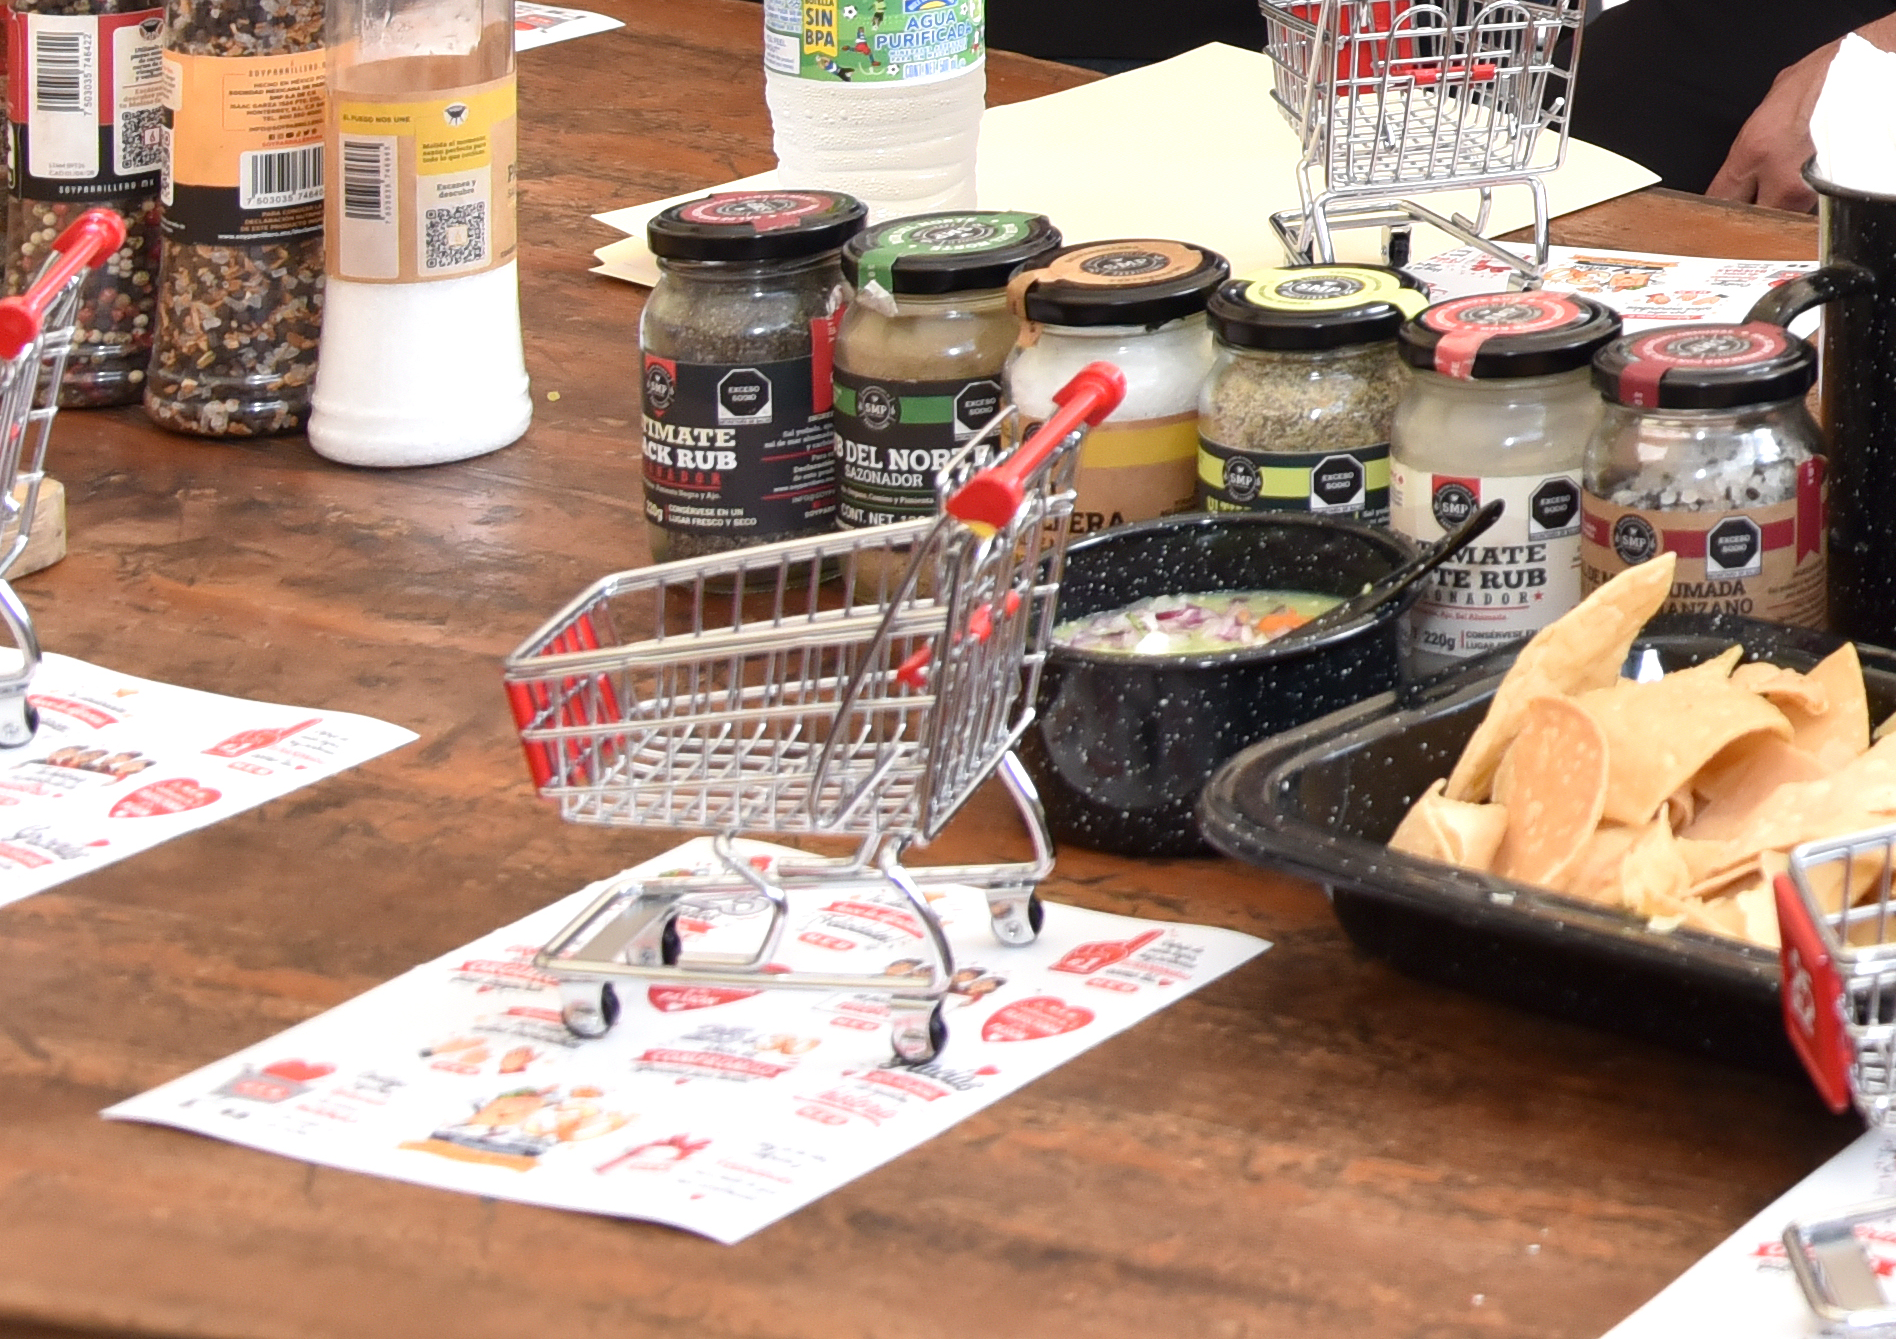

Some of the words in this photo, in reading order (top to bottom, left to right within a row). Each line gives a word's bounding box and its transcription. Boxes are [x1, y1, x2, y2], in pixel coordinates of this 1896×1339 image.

[806, 7, 833, 27] SIN
[906, 10, 957, 31] AGUA
[806, 29, 835, 47] BPA
[876, 20, 973, 50] PURIFICADA
[257, 195, 294, 204] 503035
[728, 385, 760, 393] EXCESO
[676, 448, 737, 470] RUB
[845, 440, 883, 470] DEL
[844, 463, 924, 488] SAZONADOR
[1230, 473, 1253, 486] SMP
[1321, 471, 1354, 482] EXCESO
[1442, 501, 1469, 514] SMP
[1540, 494, 1571, 506] EXCESO
[717, 508, 729, 516] EN
[691, 517, 724, 526] FRESCO
[1622, 536, 1647, 549] SMP
[1718, 534, 1751, 544] EXCESO
[1480, 567, 1547, 589] RUB
[1669, 579, 1747, 598] UMADA
[1424, 630, 1456, 651] 220g
